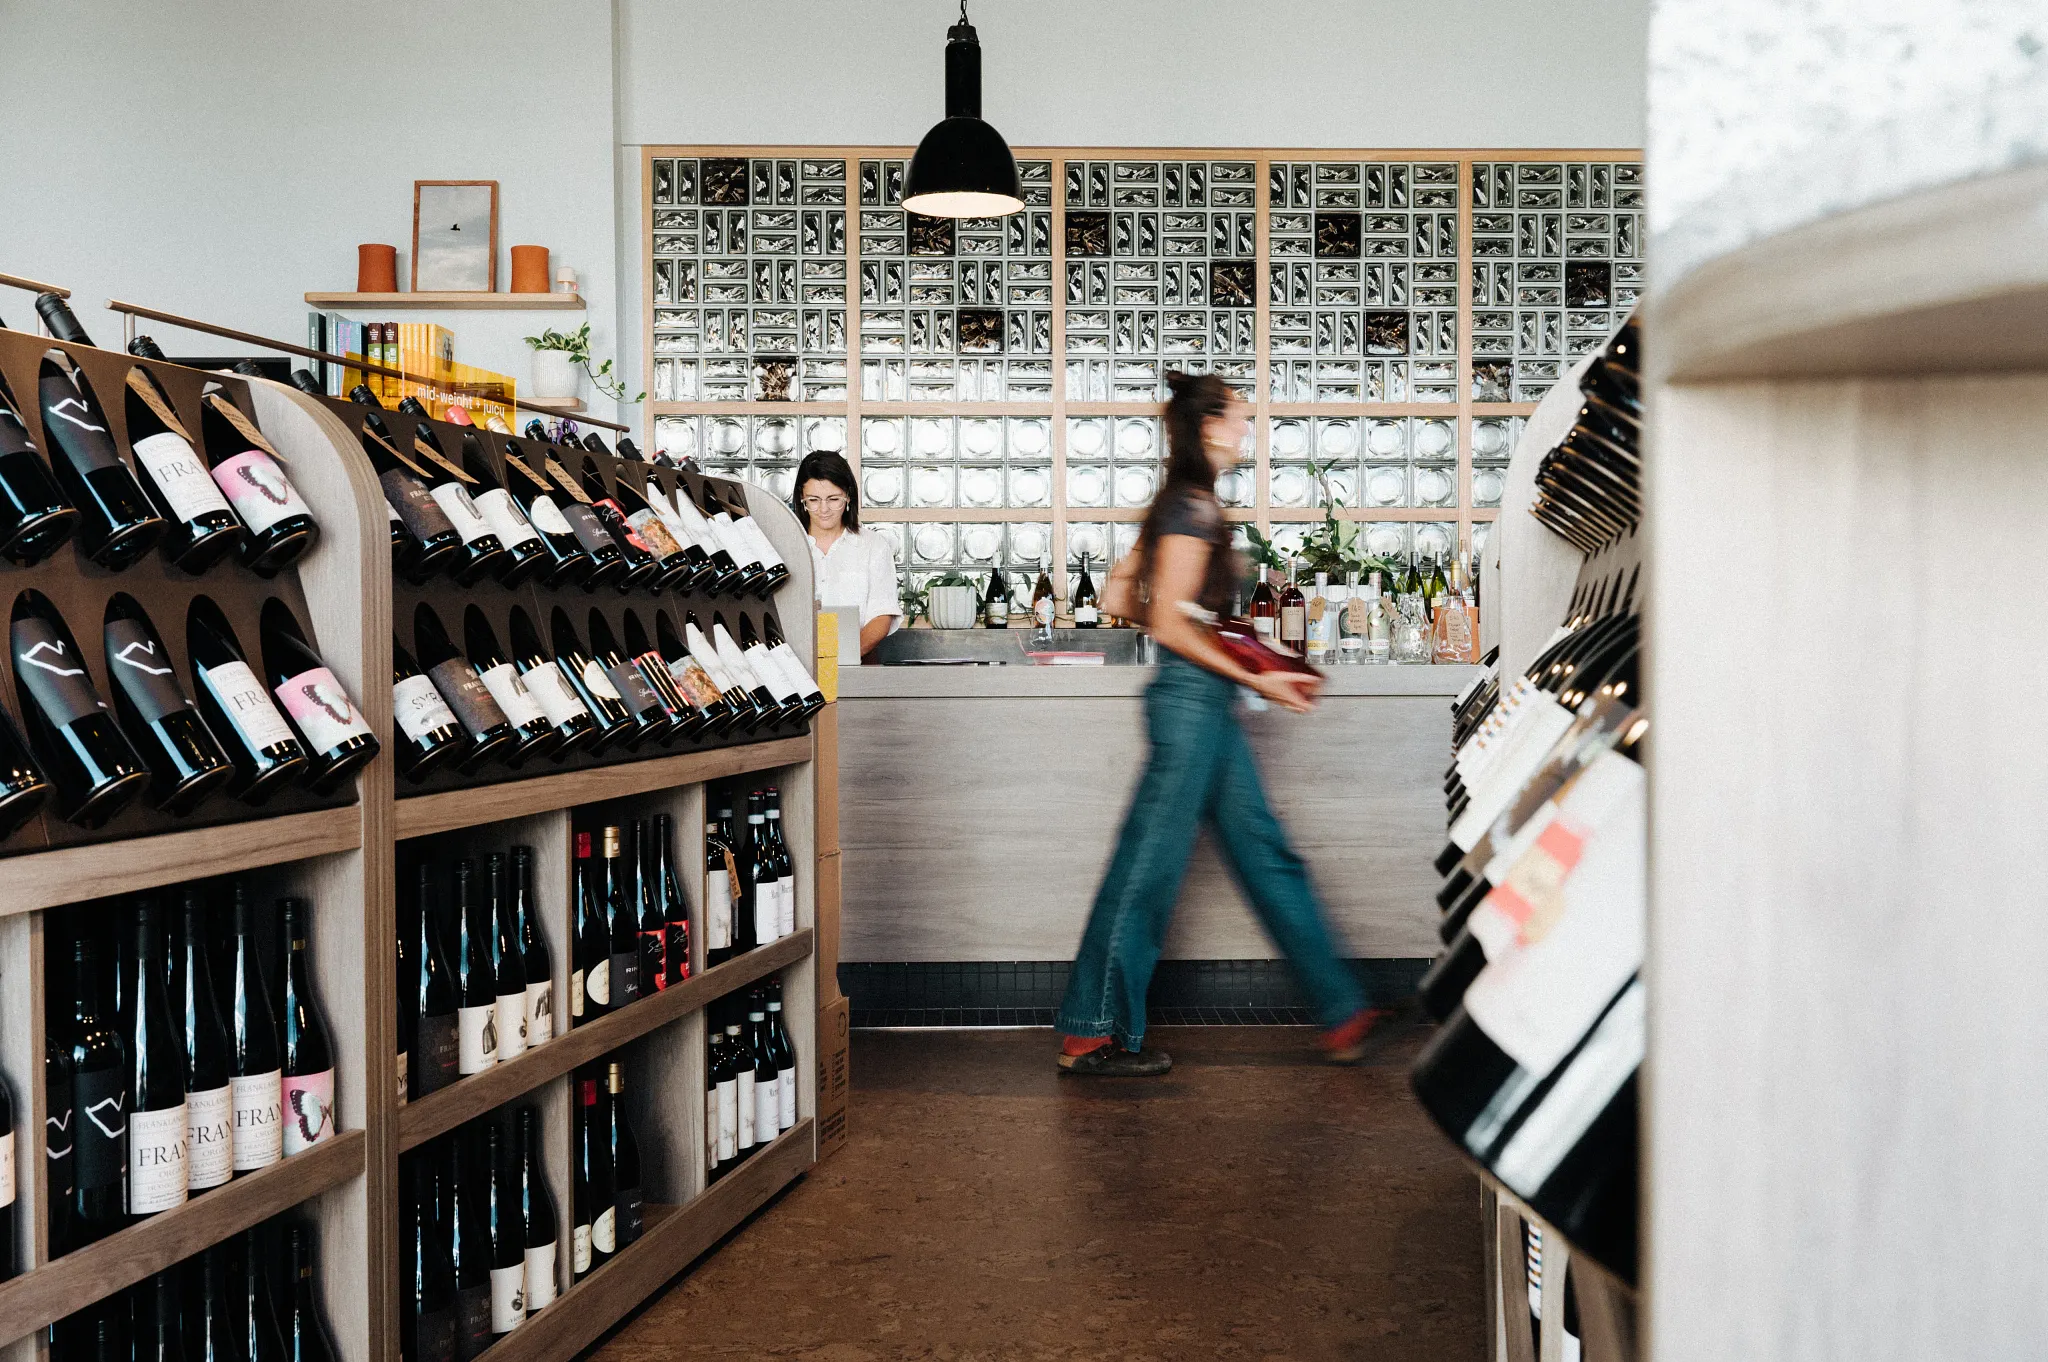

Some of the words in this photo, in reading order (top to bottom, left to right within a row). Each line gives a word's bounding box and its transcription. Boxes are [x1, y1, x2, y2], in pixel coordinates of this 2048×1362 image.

[417, 385, 473, 409] mid-weight
[483, 399, 505, 420] juicy
[411, 692, 443, 710] SYR
